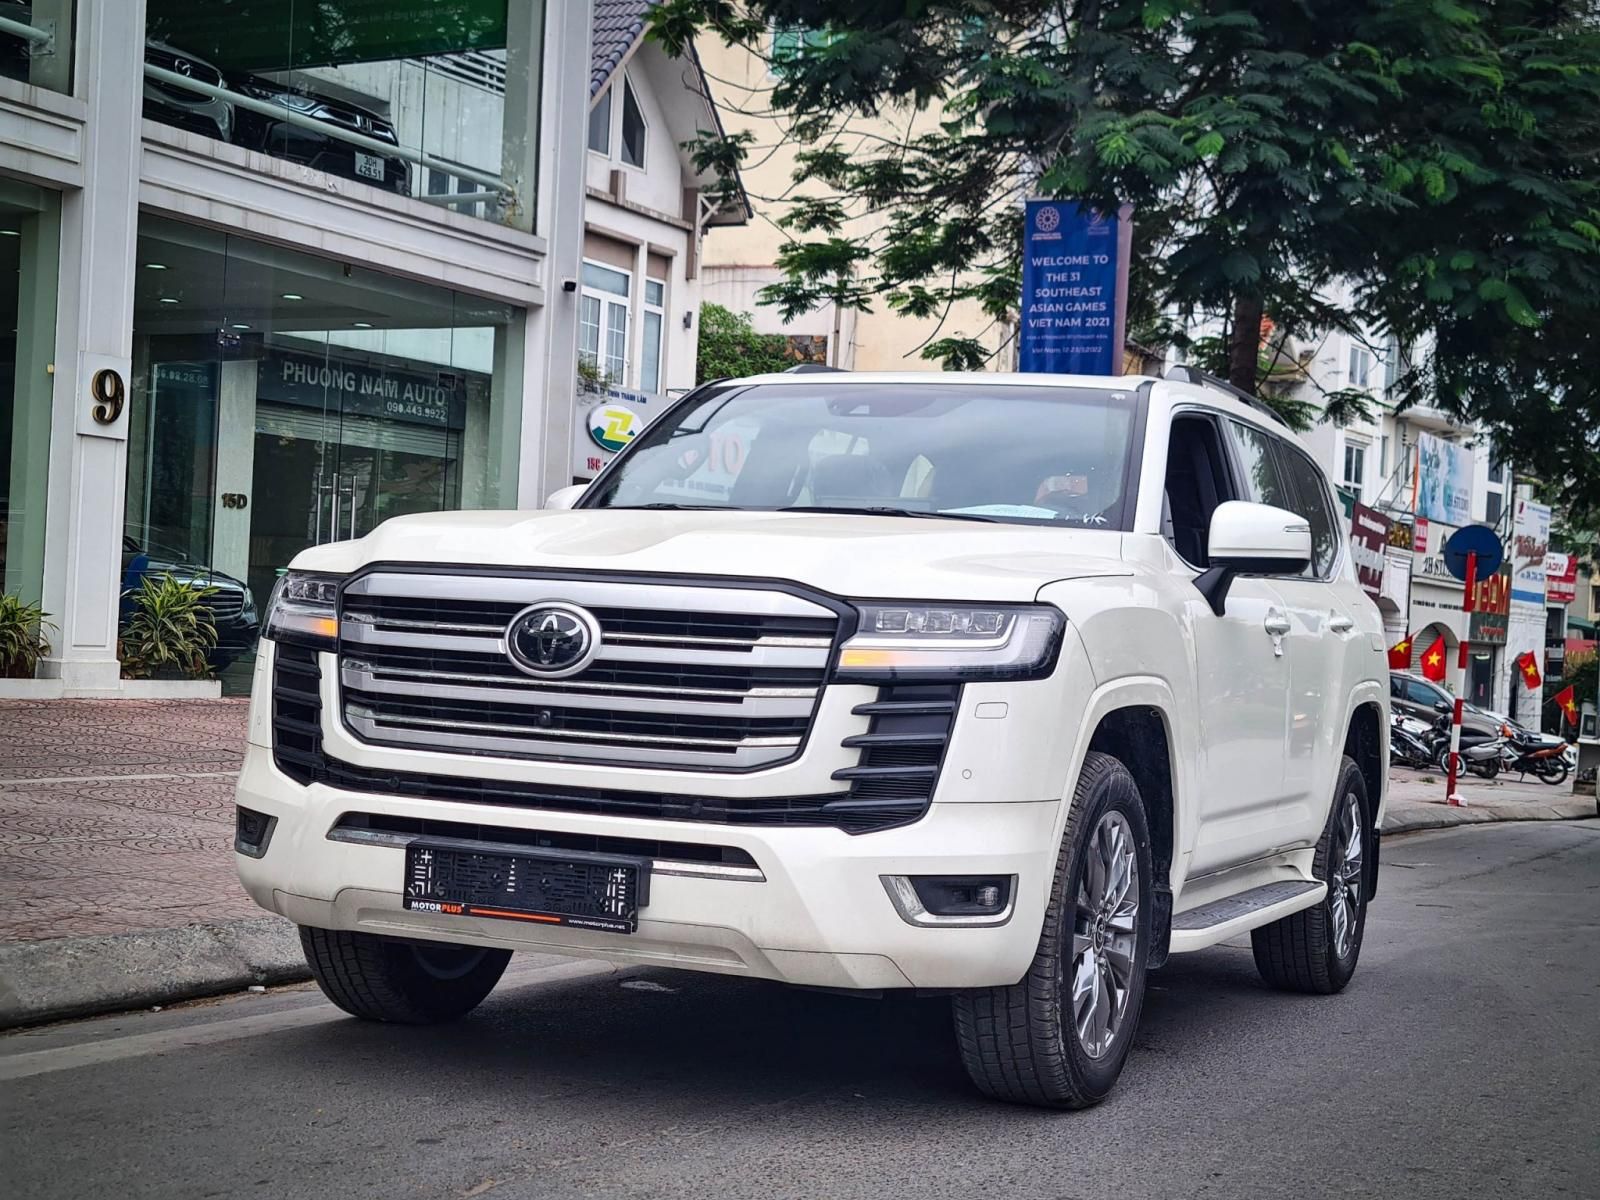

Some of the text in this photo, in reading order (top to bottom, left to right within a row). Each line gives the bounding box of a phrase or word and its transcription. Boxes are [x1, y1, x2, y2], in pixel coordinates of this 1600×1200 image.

[1031, 254, 1109, 267] WELCOME TO
[1046, 272, 1081, 282] THE 31
[1035, 286, 1103, 298] SOUTHEAST
[1029, 302, 1107, 313] ASIAN GAMES
[1028, 317, 1110, 328] VIET NAM 2021
[359, 374, 398, 399] NAM
[402, 382, 446, 406] AUTO
[92, 369, 125, 426] 9
[221, 492, 248, 510] 15D
[411, 901, 462, 913] MOTORPLUS
